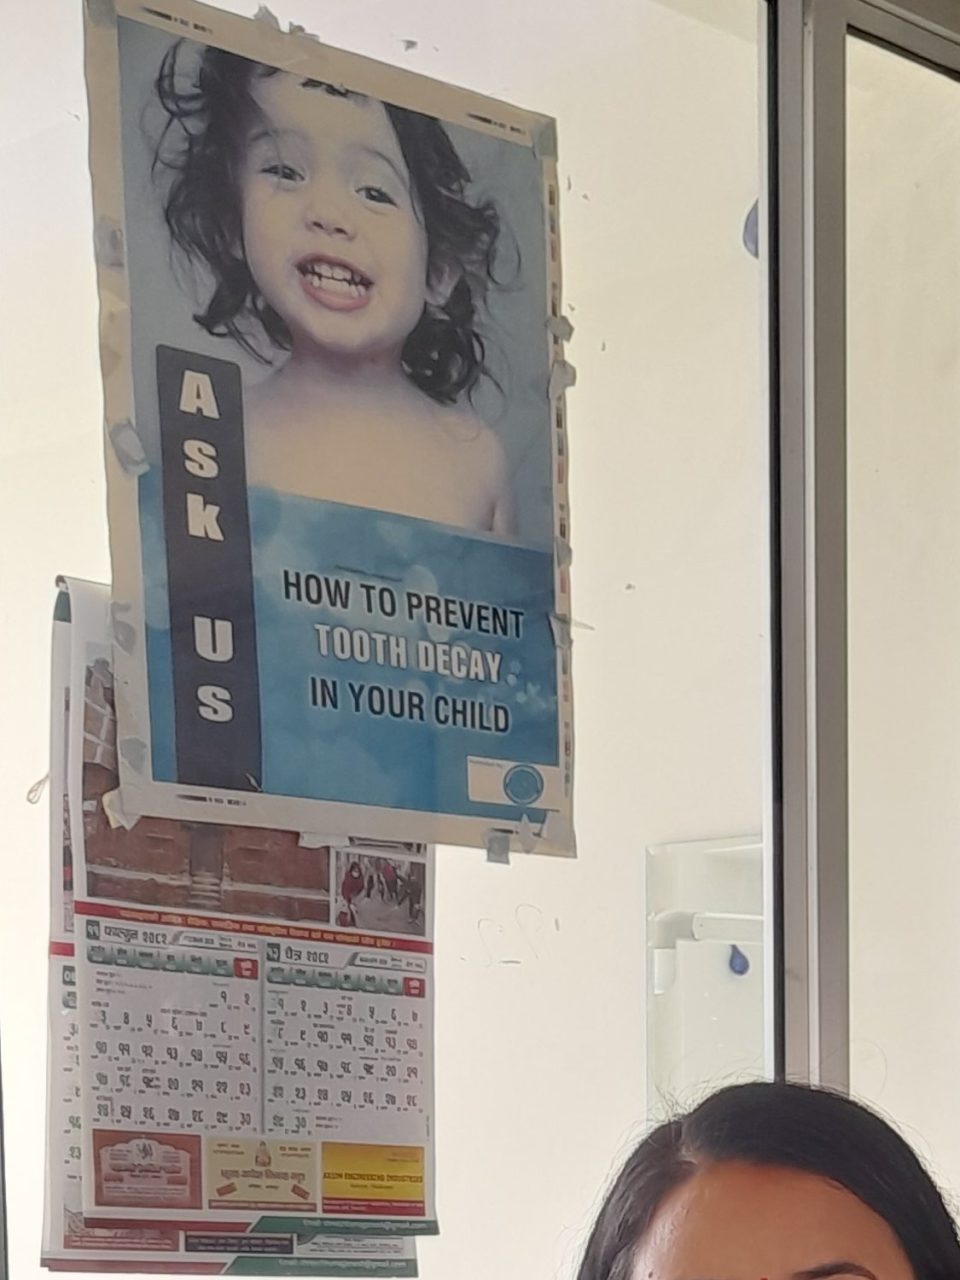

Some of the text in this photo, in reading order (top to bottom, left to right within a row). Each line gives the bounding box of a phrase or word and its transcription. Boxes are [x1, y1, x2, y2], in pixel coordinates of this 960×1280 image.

[283, 569, 525, 639] HOW TO PREVENT
[314, 622, 503, 684] TOOTH DECAY
[309, 676, 511, 734] IN YOUR CHILD
